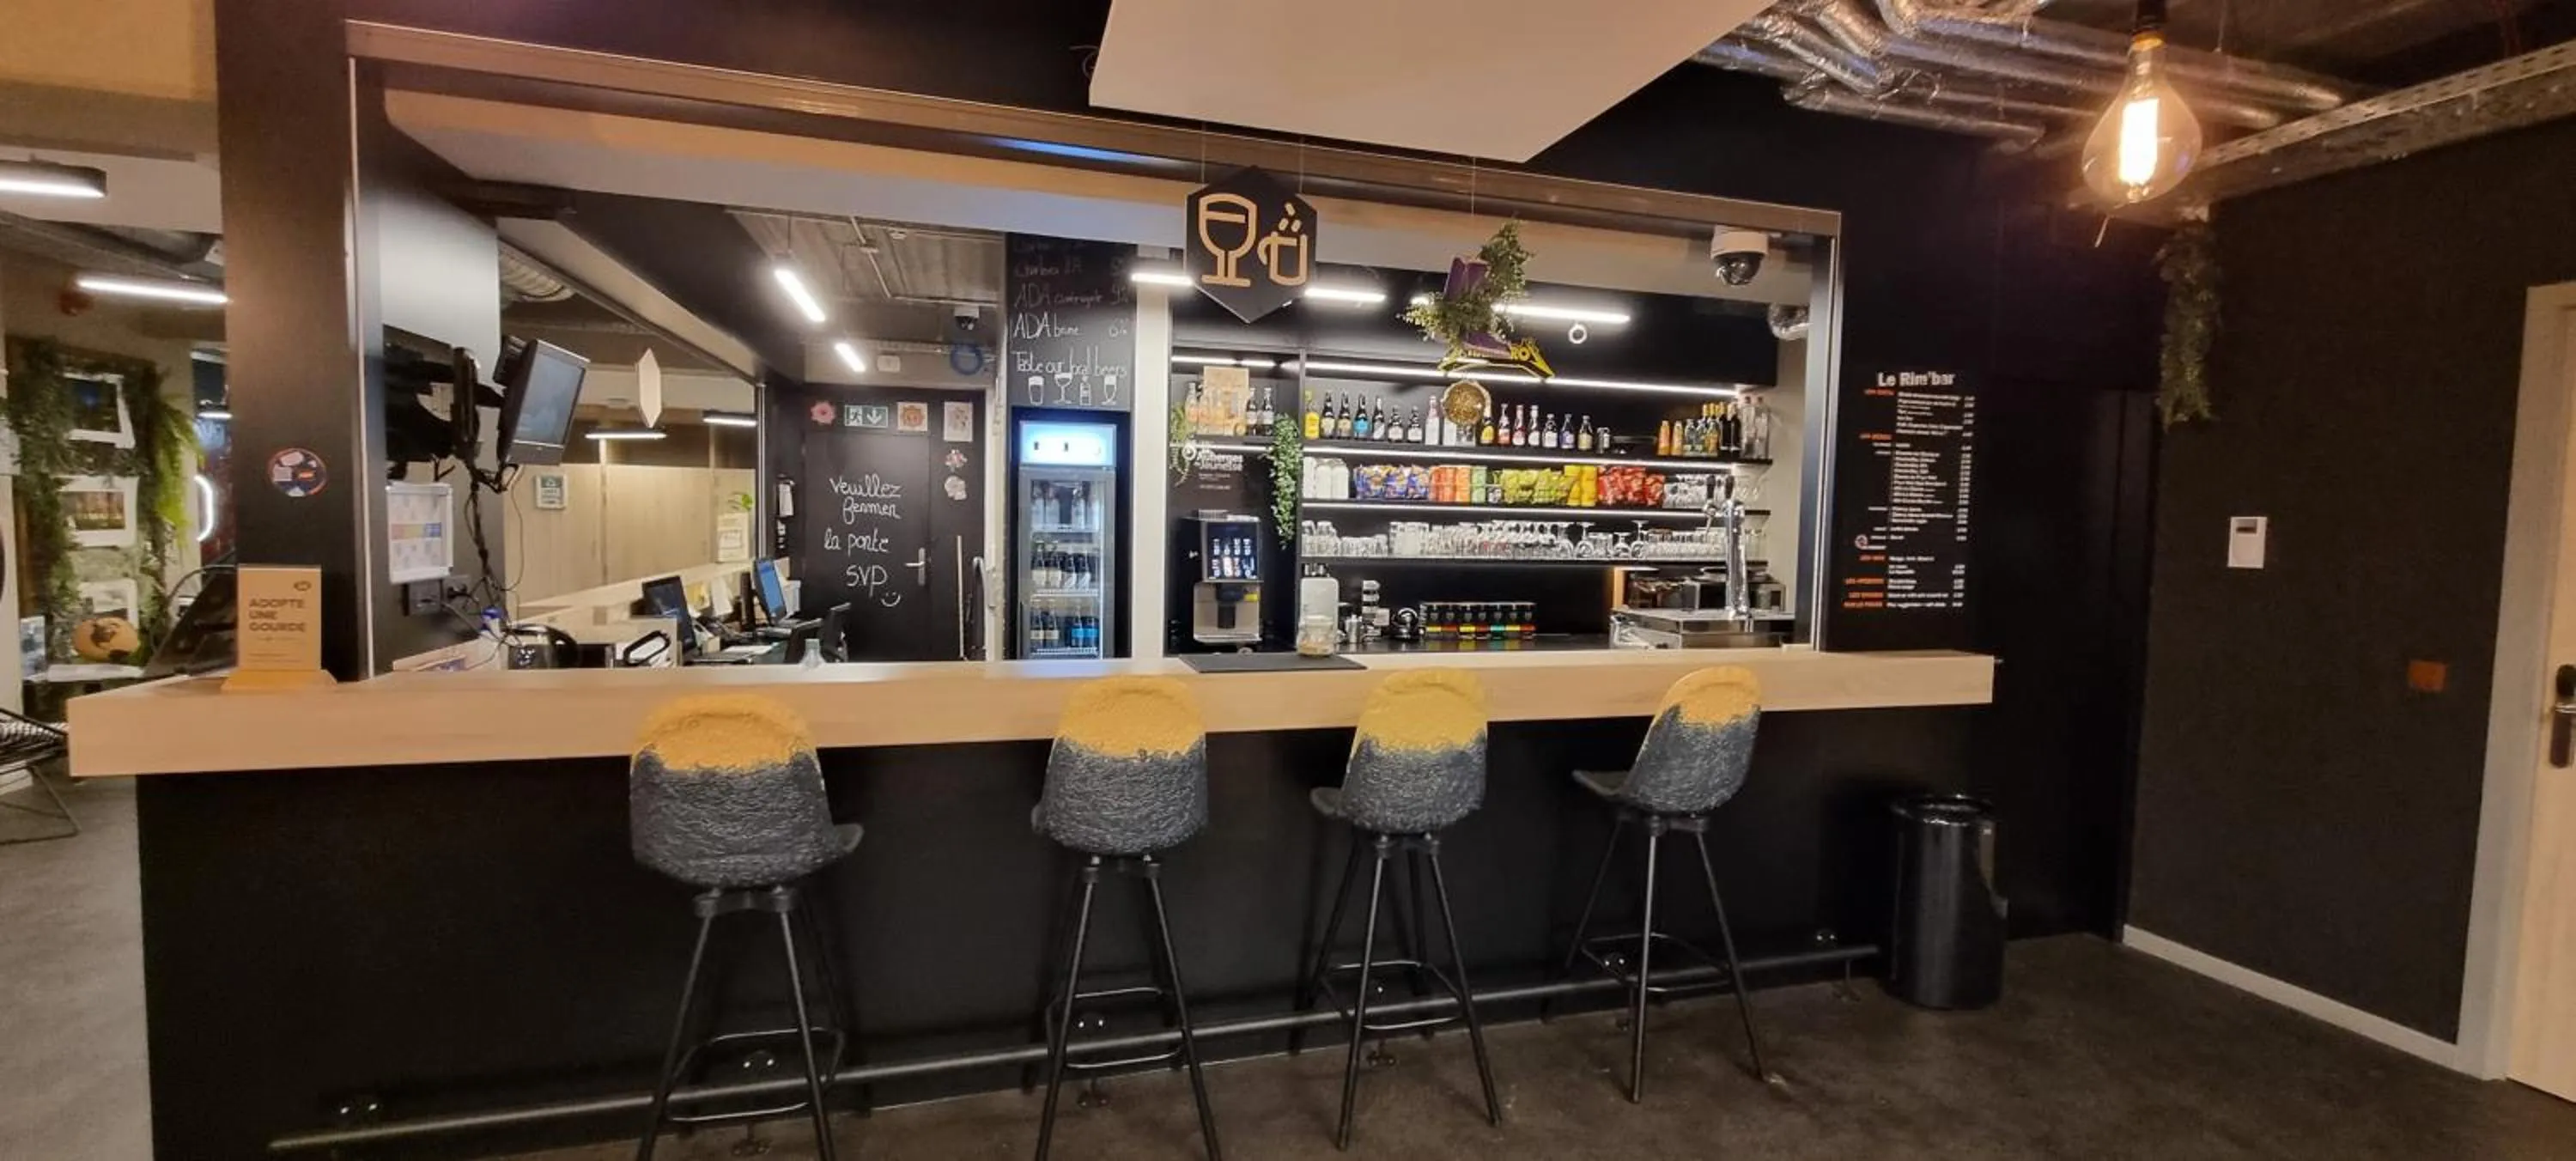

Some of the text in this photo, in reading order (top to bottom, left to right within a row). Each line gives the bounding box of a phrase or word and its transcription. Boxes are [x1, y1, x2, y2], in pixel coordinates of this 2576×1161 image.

[1013, 311, 1051, 339] ADA
[1877, 371, 1955, 386] Le Rim'bar
[829, 473, 902, 498] Veuillez
[842, 495, 902, 525] fermer
[824, 527, 890, 557] la porte
[846, 564, 888, 597] SVP
[249, 598, 305, 608] ADOPTE
[249, 610, 277, 620] UNE
[249, 622, 307, 632] GOURDE
